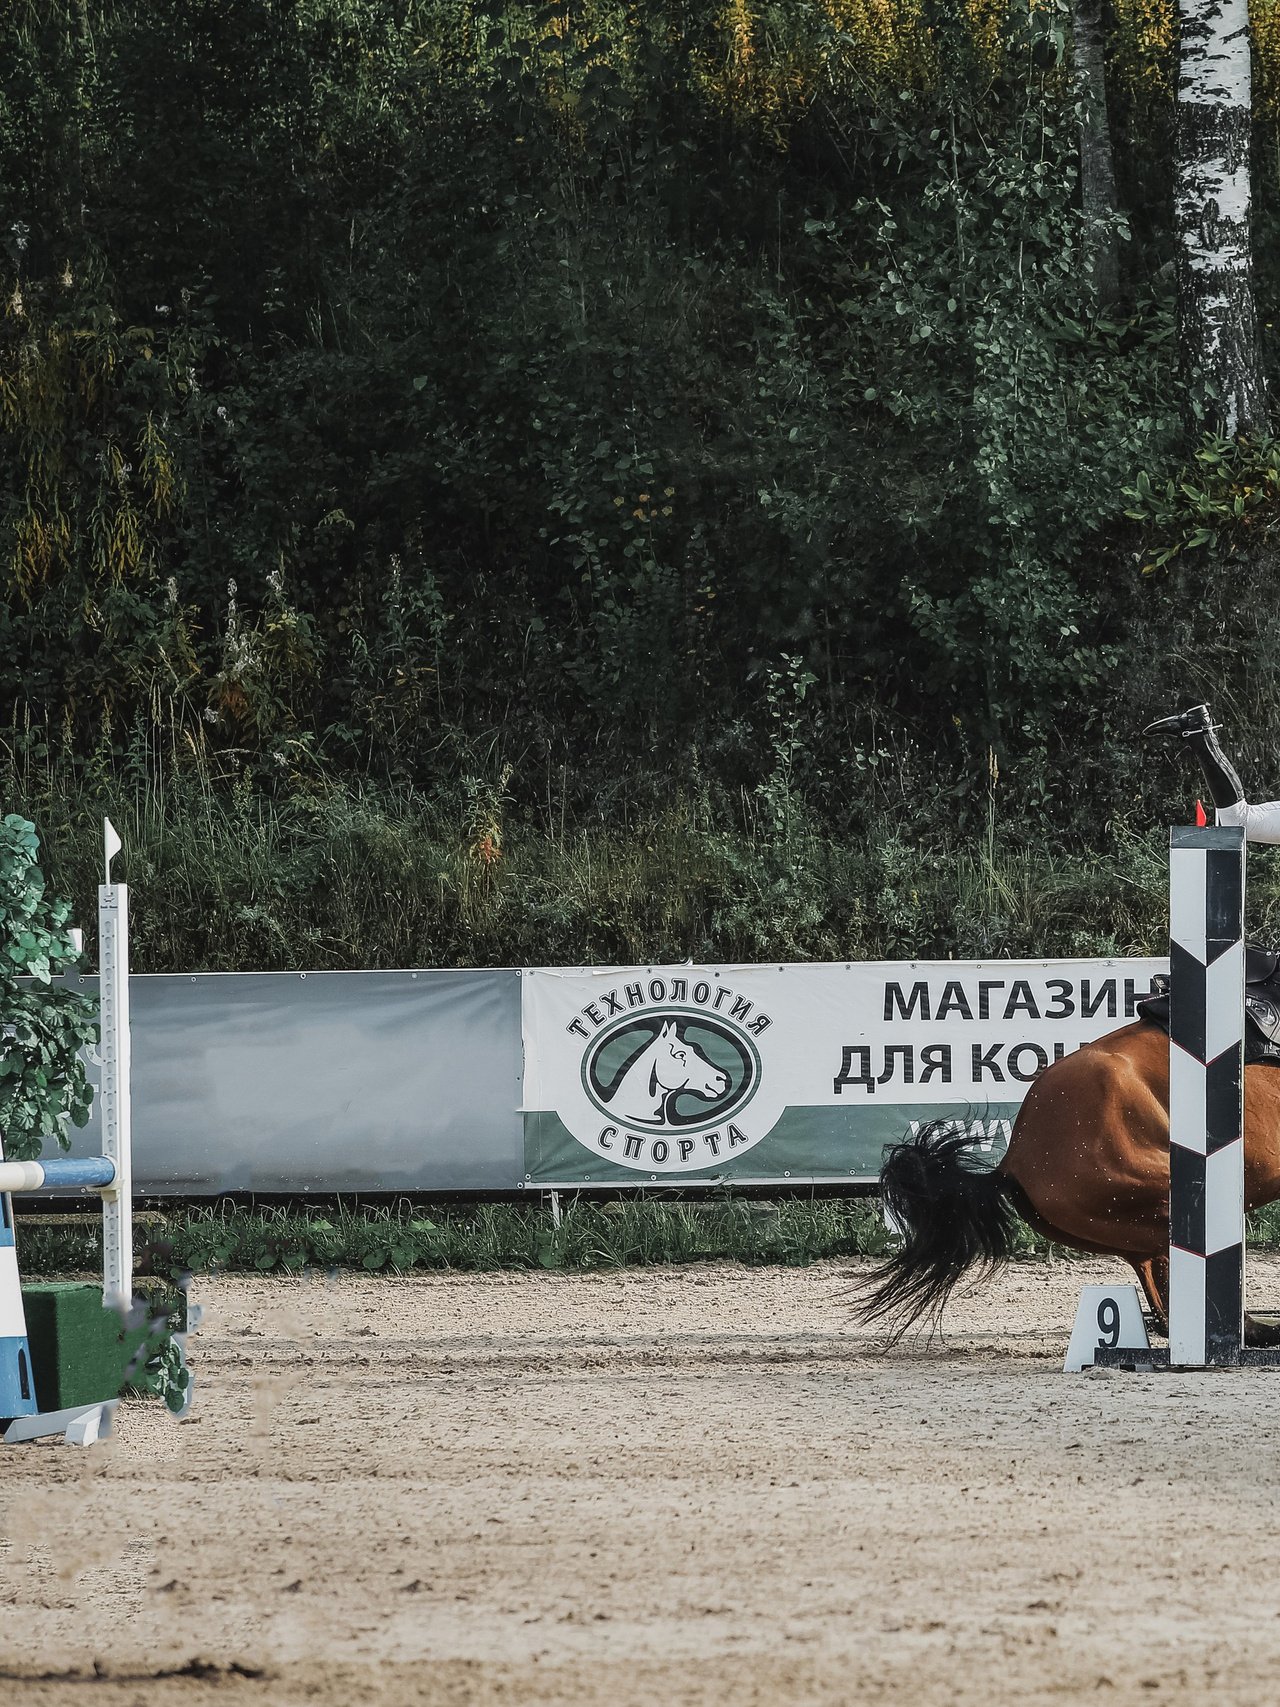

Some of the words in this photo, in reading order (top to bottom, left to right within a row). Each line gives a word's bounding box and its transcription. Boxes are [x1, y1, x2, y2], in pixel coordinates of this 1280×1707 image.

[567, 978, 773, 1040] ТЕХНОЛОГИЯ
[833, 1044, 952, 1094] ДЛЯ
[599, 1124, 748, 1162] СПОРТА
[1097, 1297, 1120, 1348] 9
